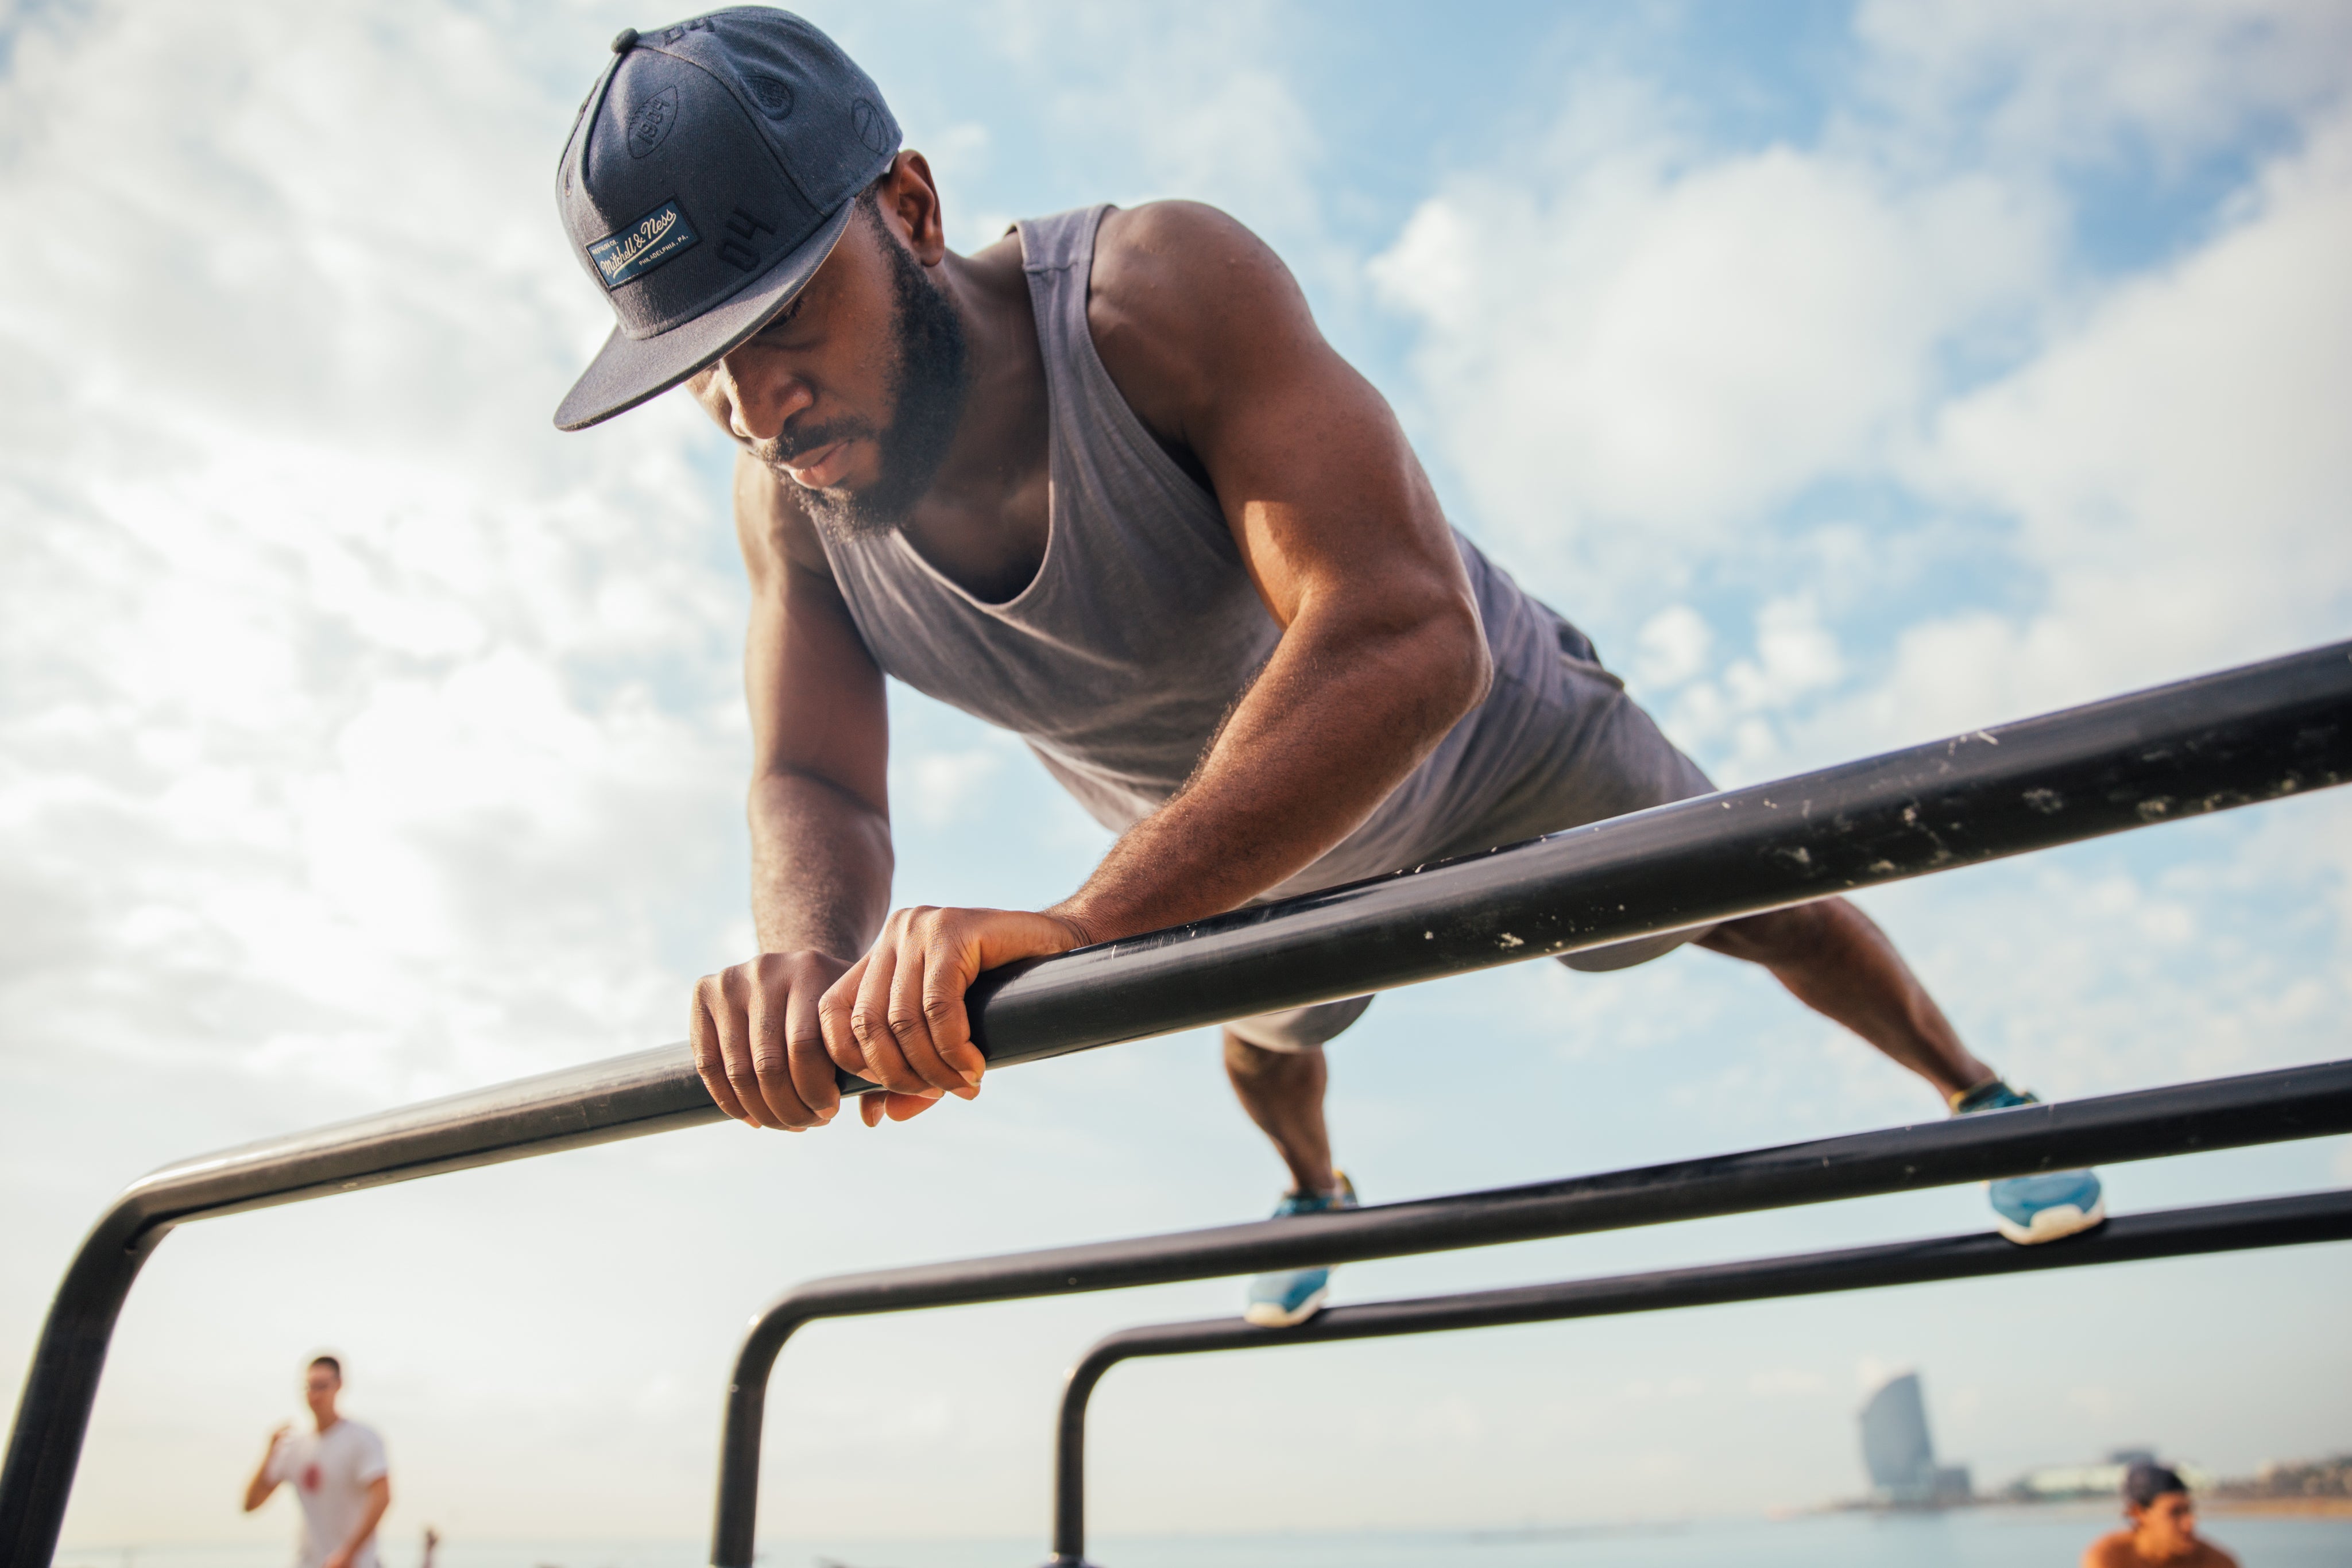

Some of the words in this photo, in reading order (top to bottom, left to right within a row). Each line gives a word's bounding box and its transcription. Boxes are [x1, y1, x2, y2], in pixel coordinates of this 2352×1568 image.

[636, 97, 670, 146] 1904
[600, 237, 637, 276] Mitchell
[633, 233, 646, 248] &
[640, 209, 676, 239] Ness
[639, 241, 679, 266] PHILADELPHIA,
[678, 234, 688, 243] PA.
[714, 203, 777, 272] 04
